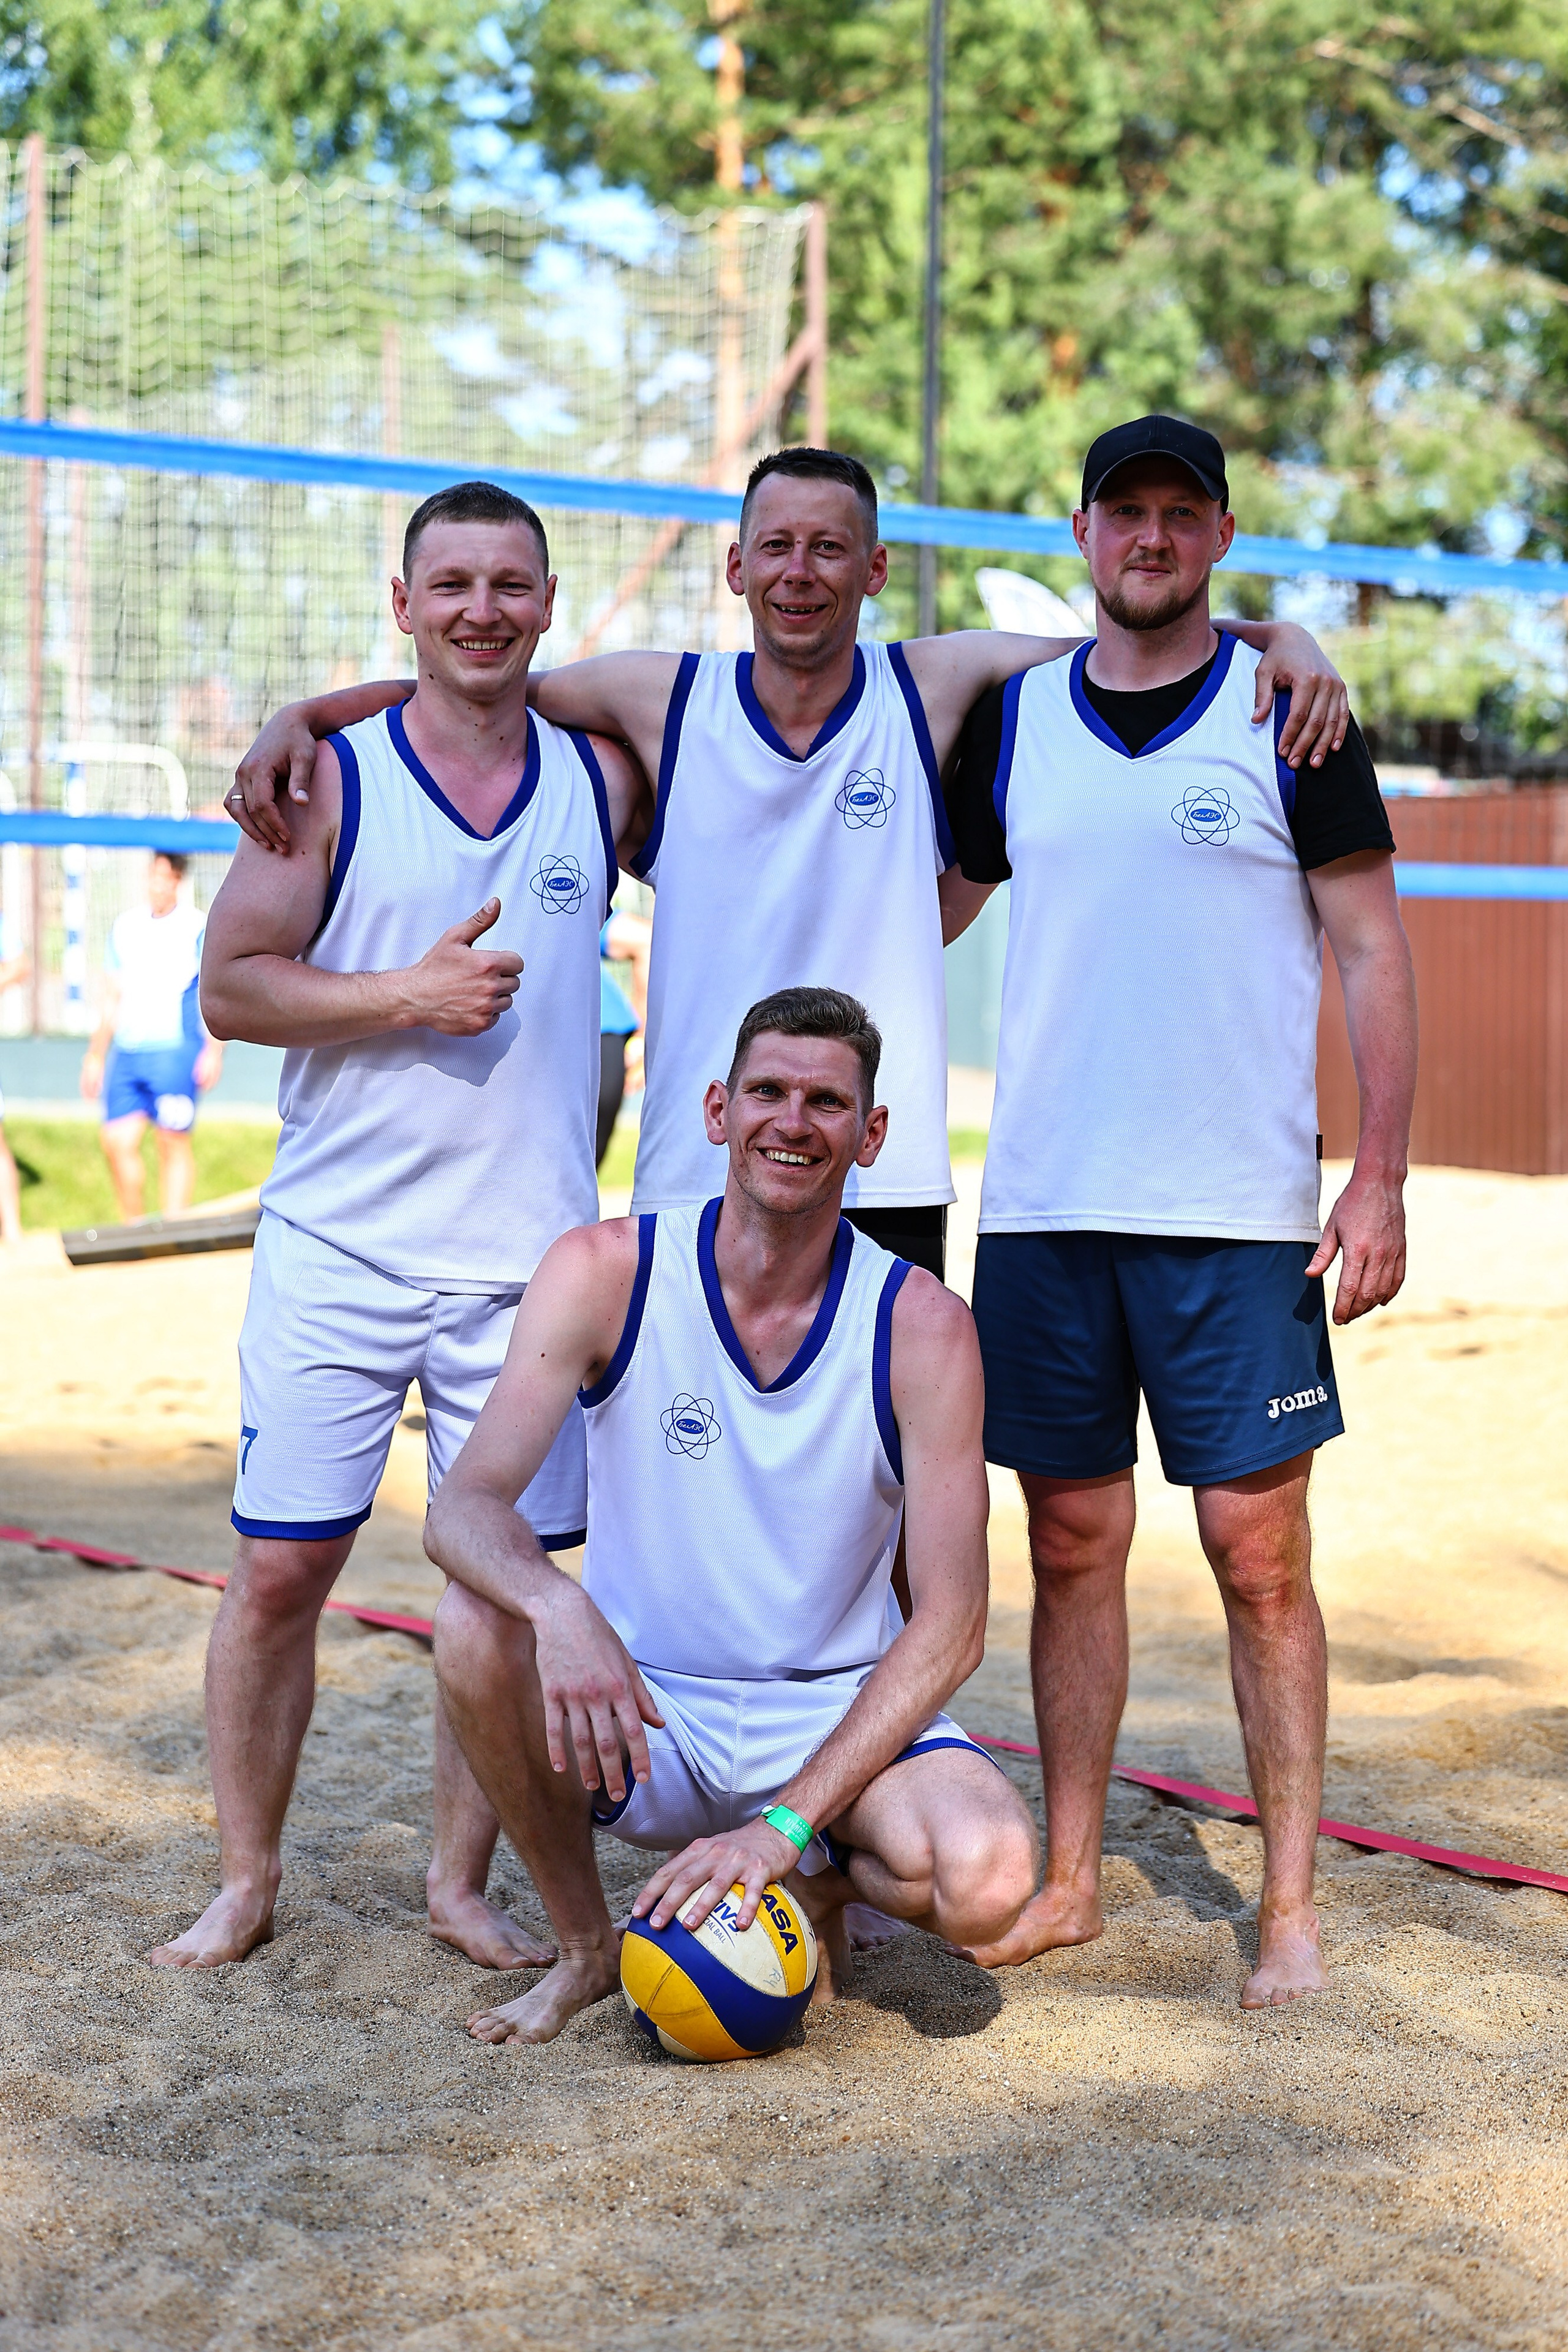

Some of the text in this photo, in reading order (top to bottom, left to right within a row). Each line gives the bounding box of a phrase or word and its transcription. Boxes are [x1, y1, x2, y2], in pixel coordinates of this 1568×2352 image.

[703, 1918, 726, 1943] CIAL BALL
[761, 1887, 798, 1956] ASA
